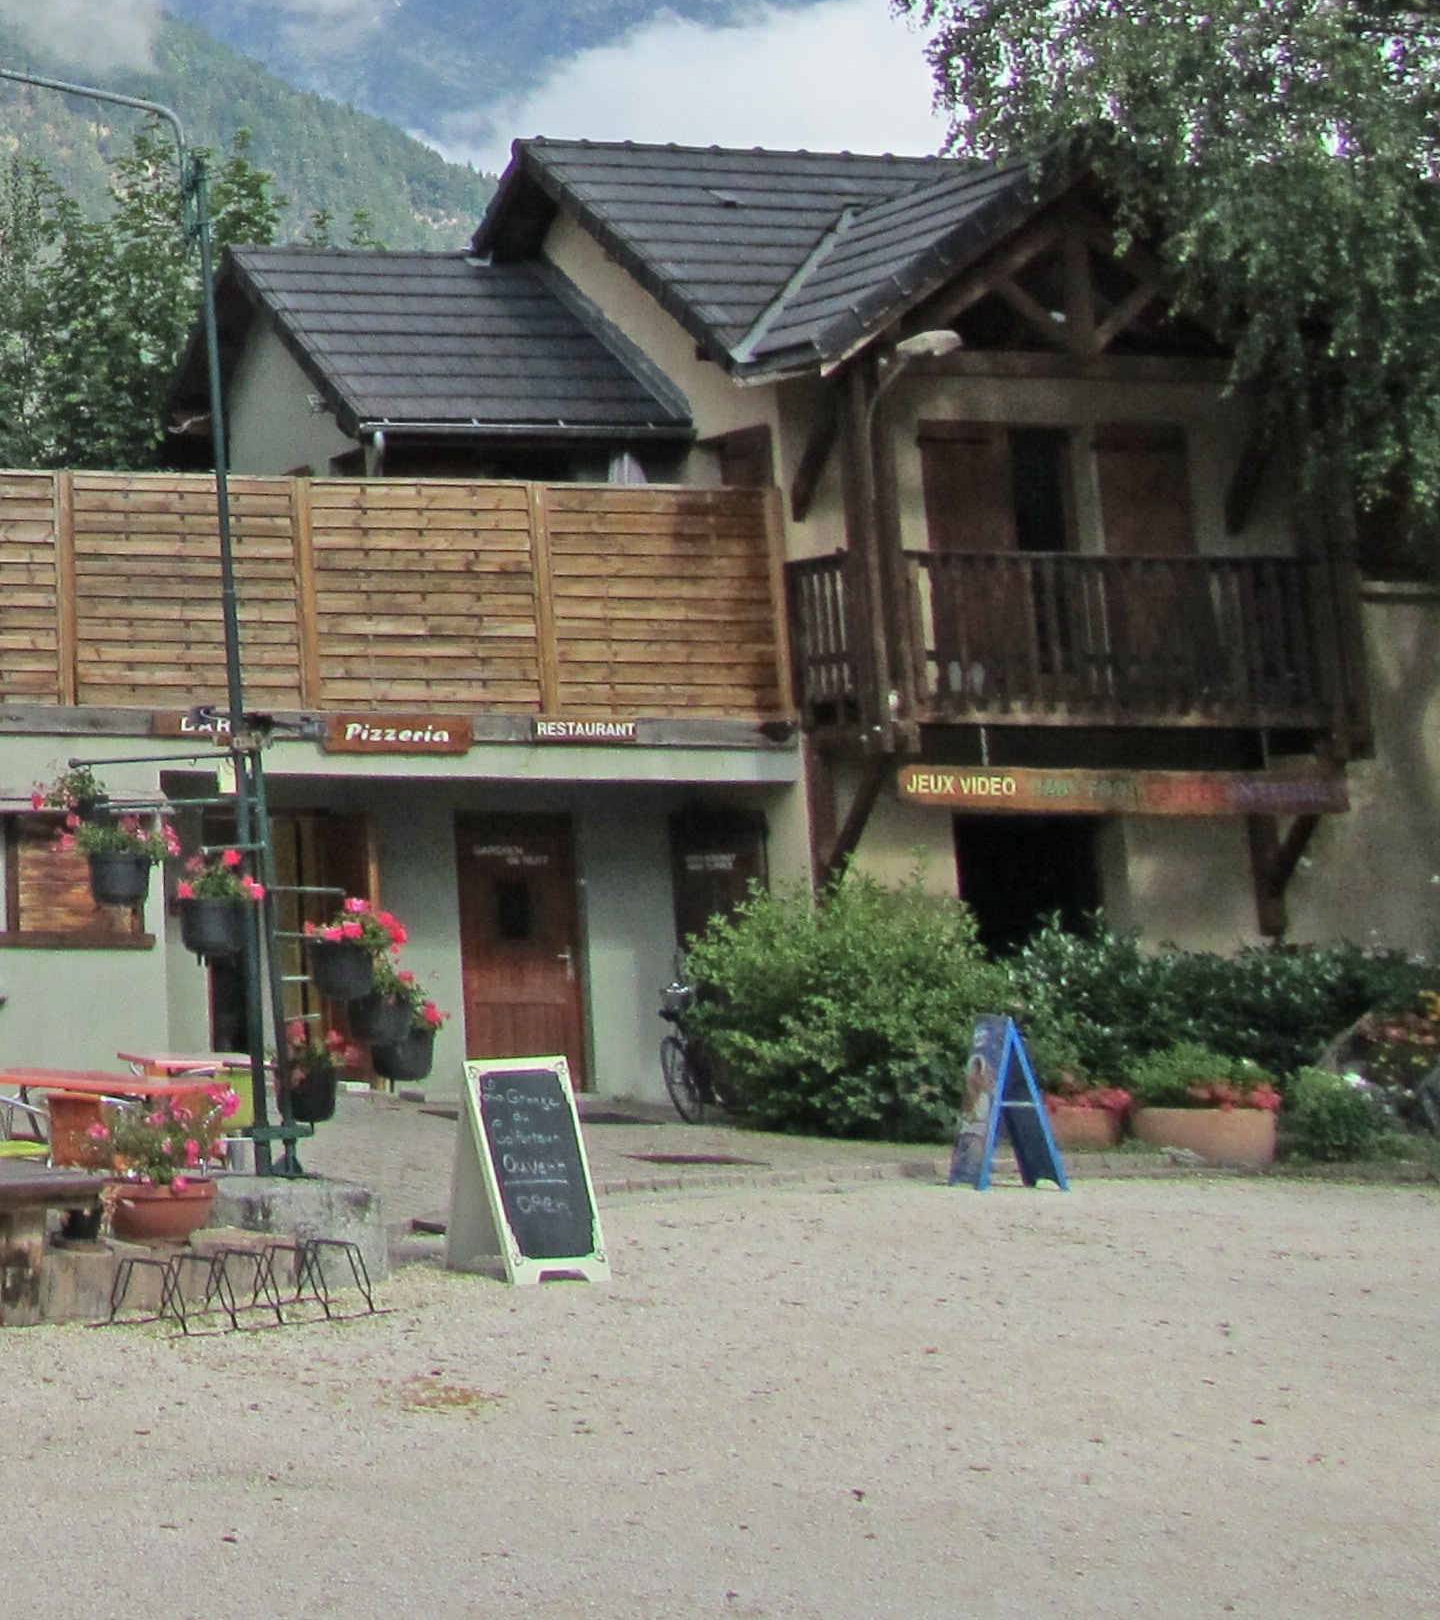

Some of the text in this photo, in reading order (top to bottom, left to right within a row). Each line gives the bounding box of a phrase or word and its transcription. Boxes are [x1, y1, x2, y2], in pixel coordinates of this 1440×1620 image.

[344, 722, 449, 743] Pizzeria
[536, 721, 635, 736] RESTAURANT
[906, 774, 956, 794] JEUX
[959, 776, 1016, 796] VIDEO
